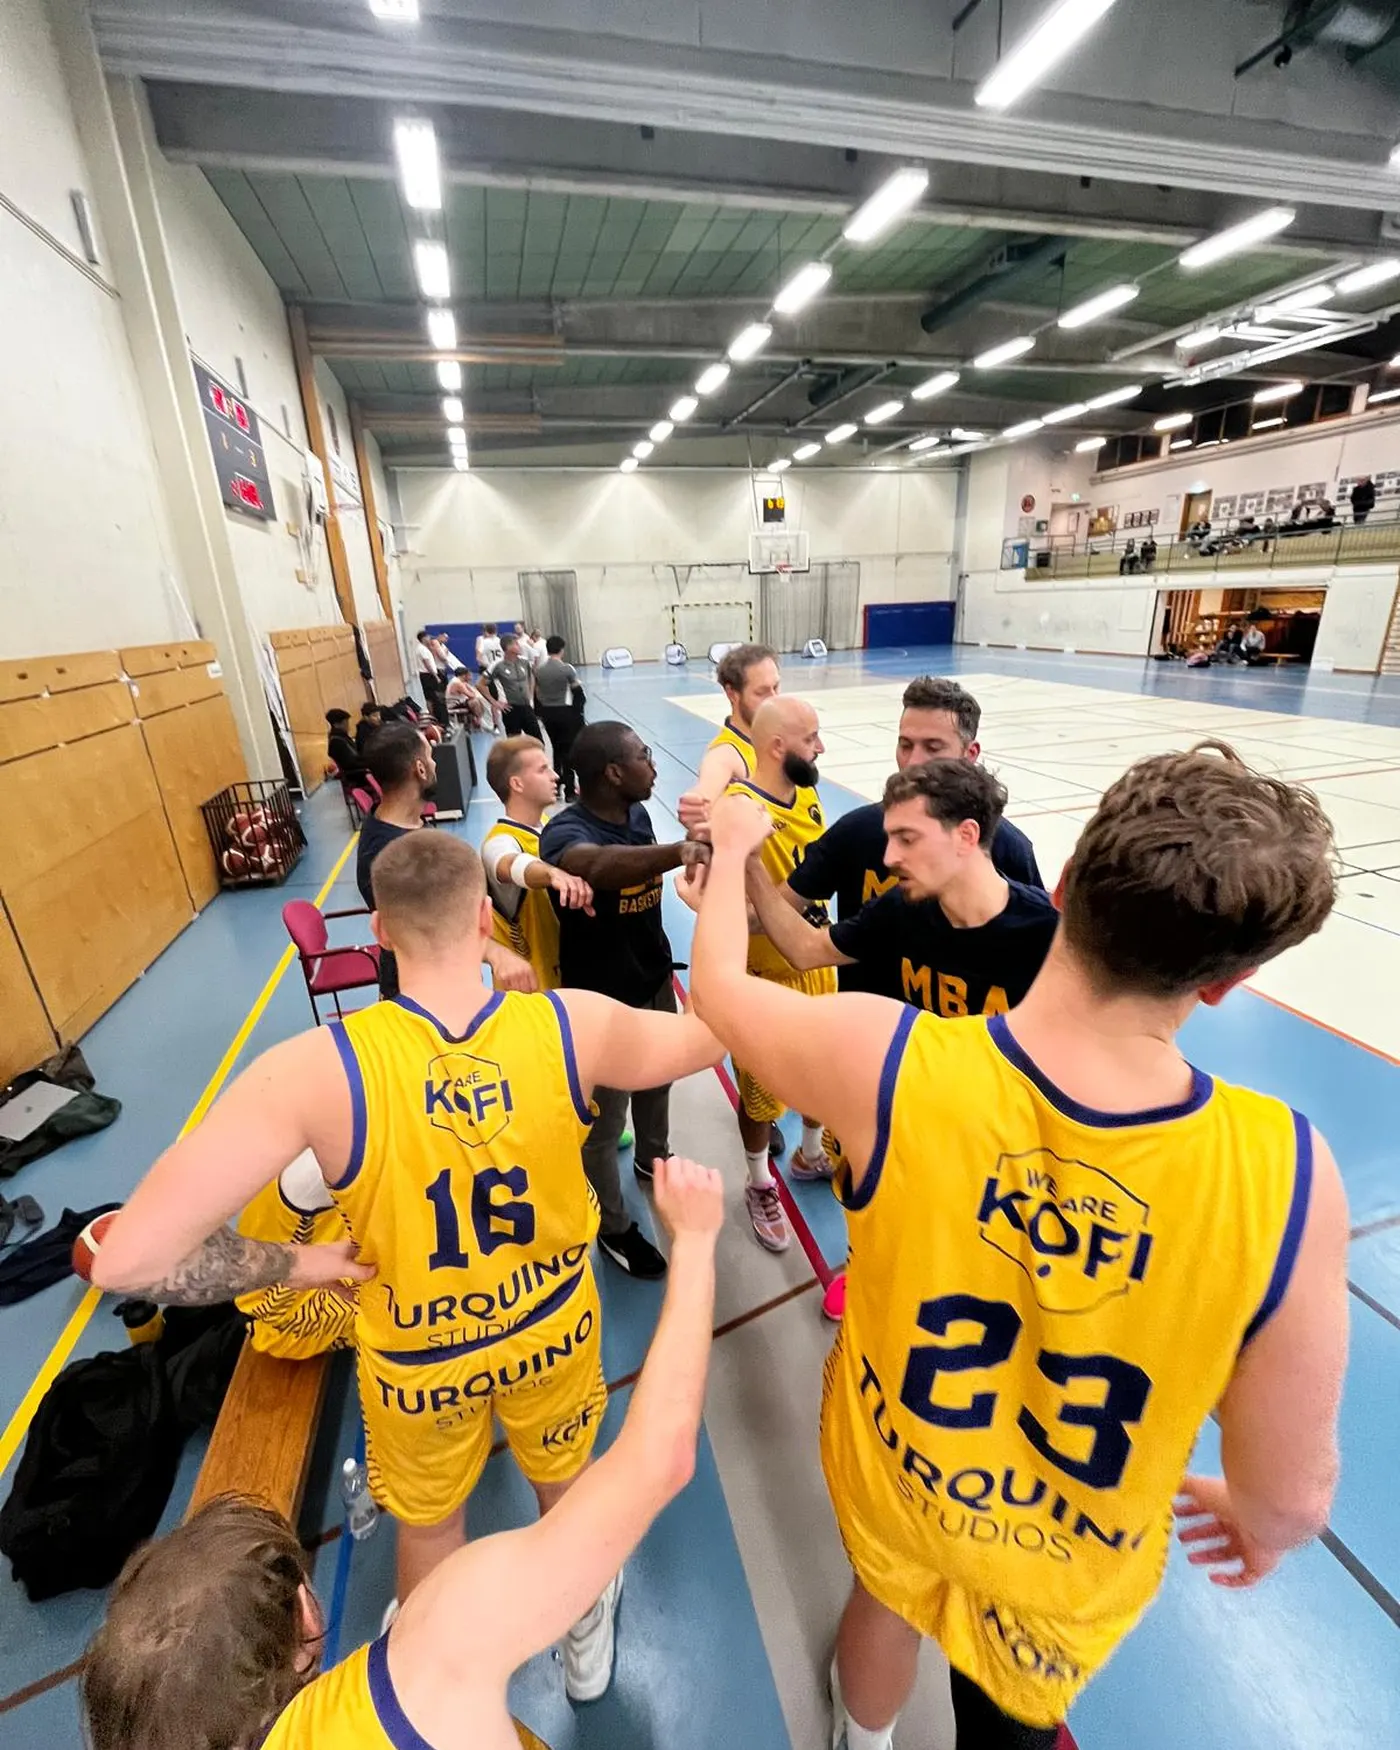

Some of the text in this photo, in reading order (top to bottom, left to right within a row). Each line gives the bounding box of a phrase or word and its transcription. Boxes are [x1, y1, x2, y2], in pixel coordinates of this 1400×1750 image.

[901, 956, 1010, 1018] MBA
[425, 1165, 535, 1272] 16
[977, 1176, 1153, 1281] KOFI
[1060, 1195, 1119, 1223] ARE
[382, 1242, 588, 1329] TURQUINO
[427, 1299, 547, 1348] STUDIO
[376, 1310, 593, 1415] TURQUINO
[899, 1293, 1155, 1490] 23
[860, 1355, 1150, 1552] TURQUIN
[897, 1472, 1073, 1563] STUDIOS
